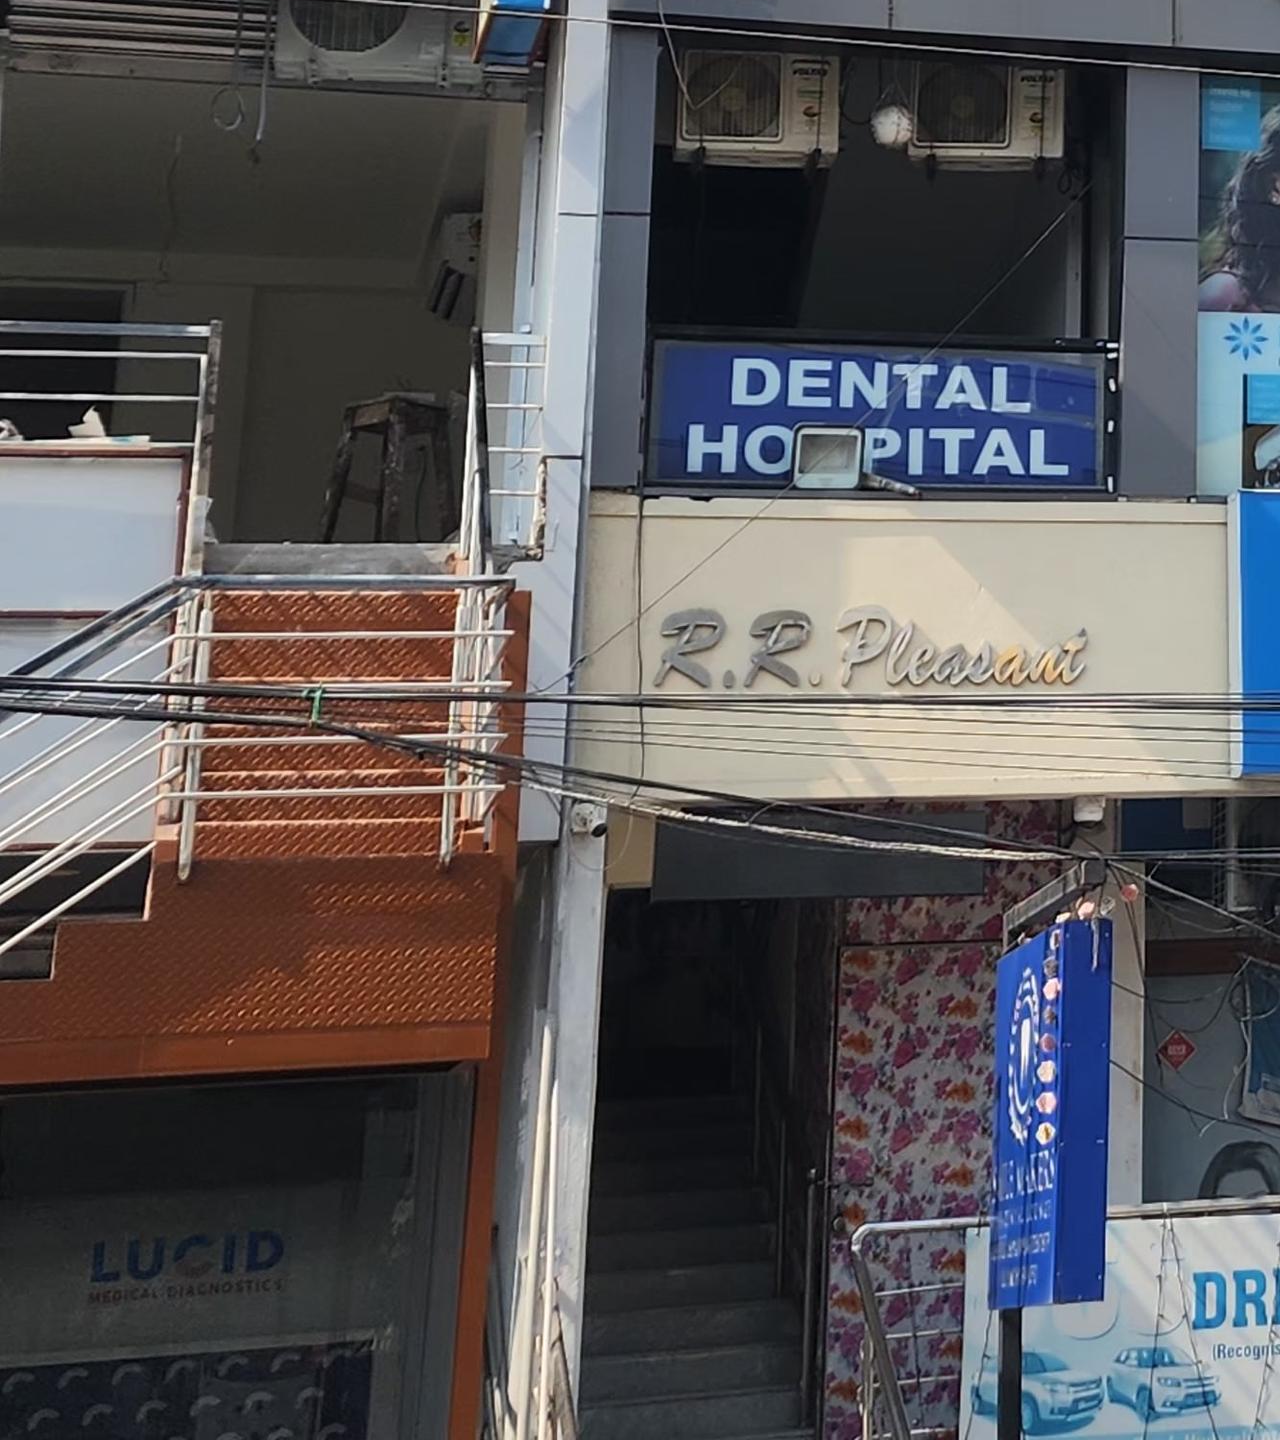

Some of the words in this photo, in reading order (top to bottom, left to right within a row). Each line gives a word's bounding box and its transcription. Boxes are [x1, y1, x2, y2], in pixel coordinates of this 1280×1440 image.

[731, 358, 1032, 414] DENTAL
[686, 423, 1070, 477] HOPITAL
[836, 604, 1089, 688] Pleasant
[90, 1231, 285, 1284] LUCID
[87, 1287, 160, 1306] MEDICAL
[167, 1278, 285, 1300] DIAGNOSTICS
